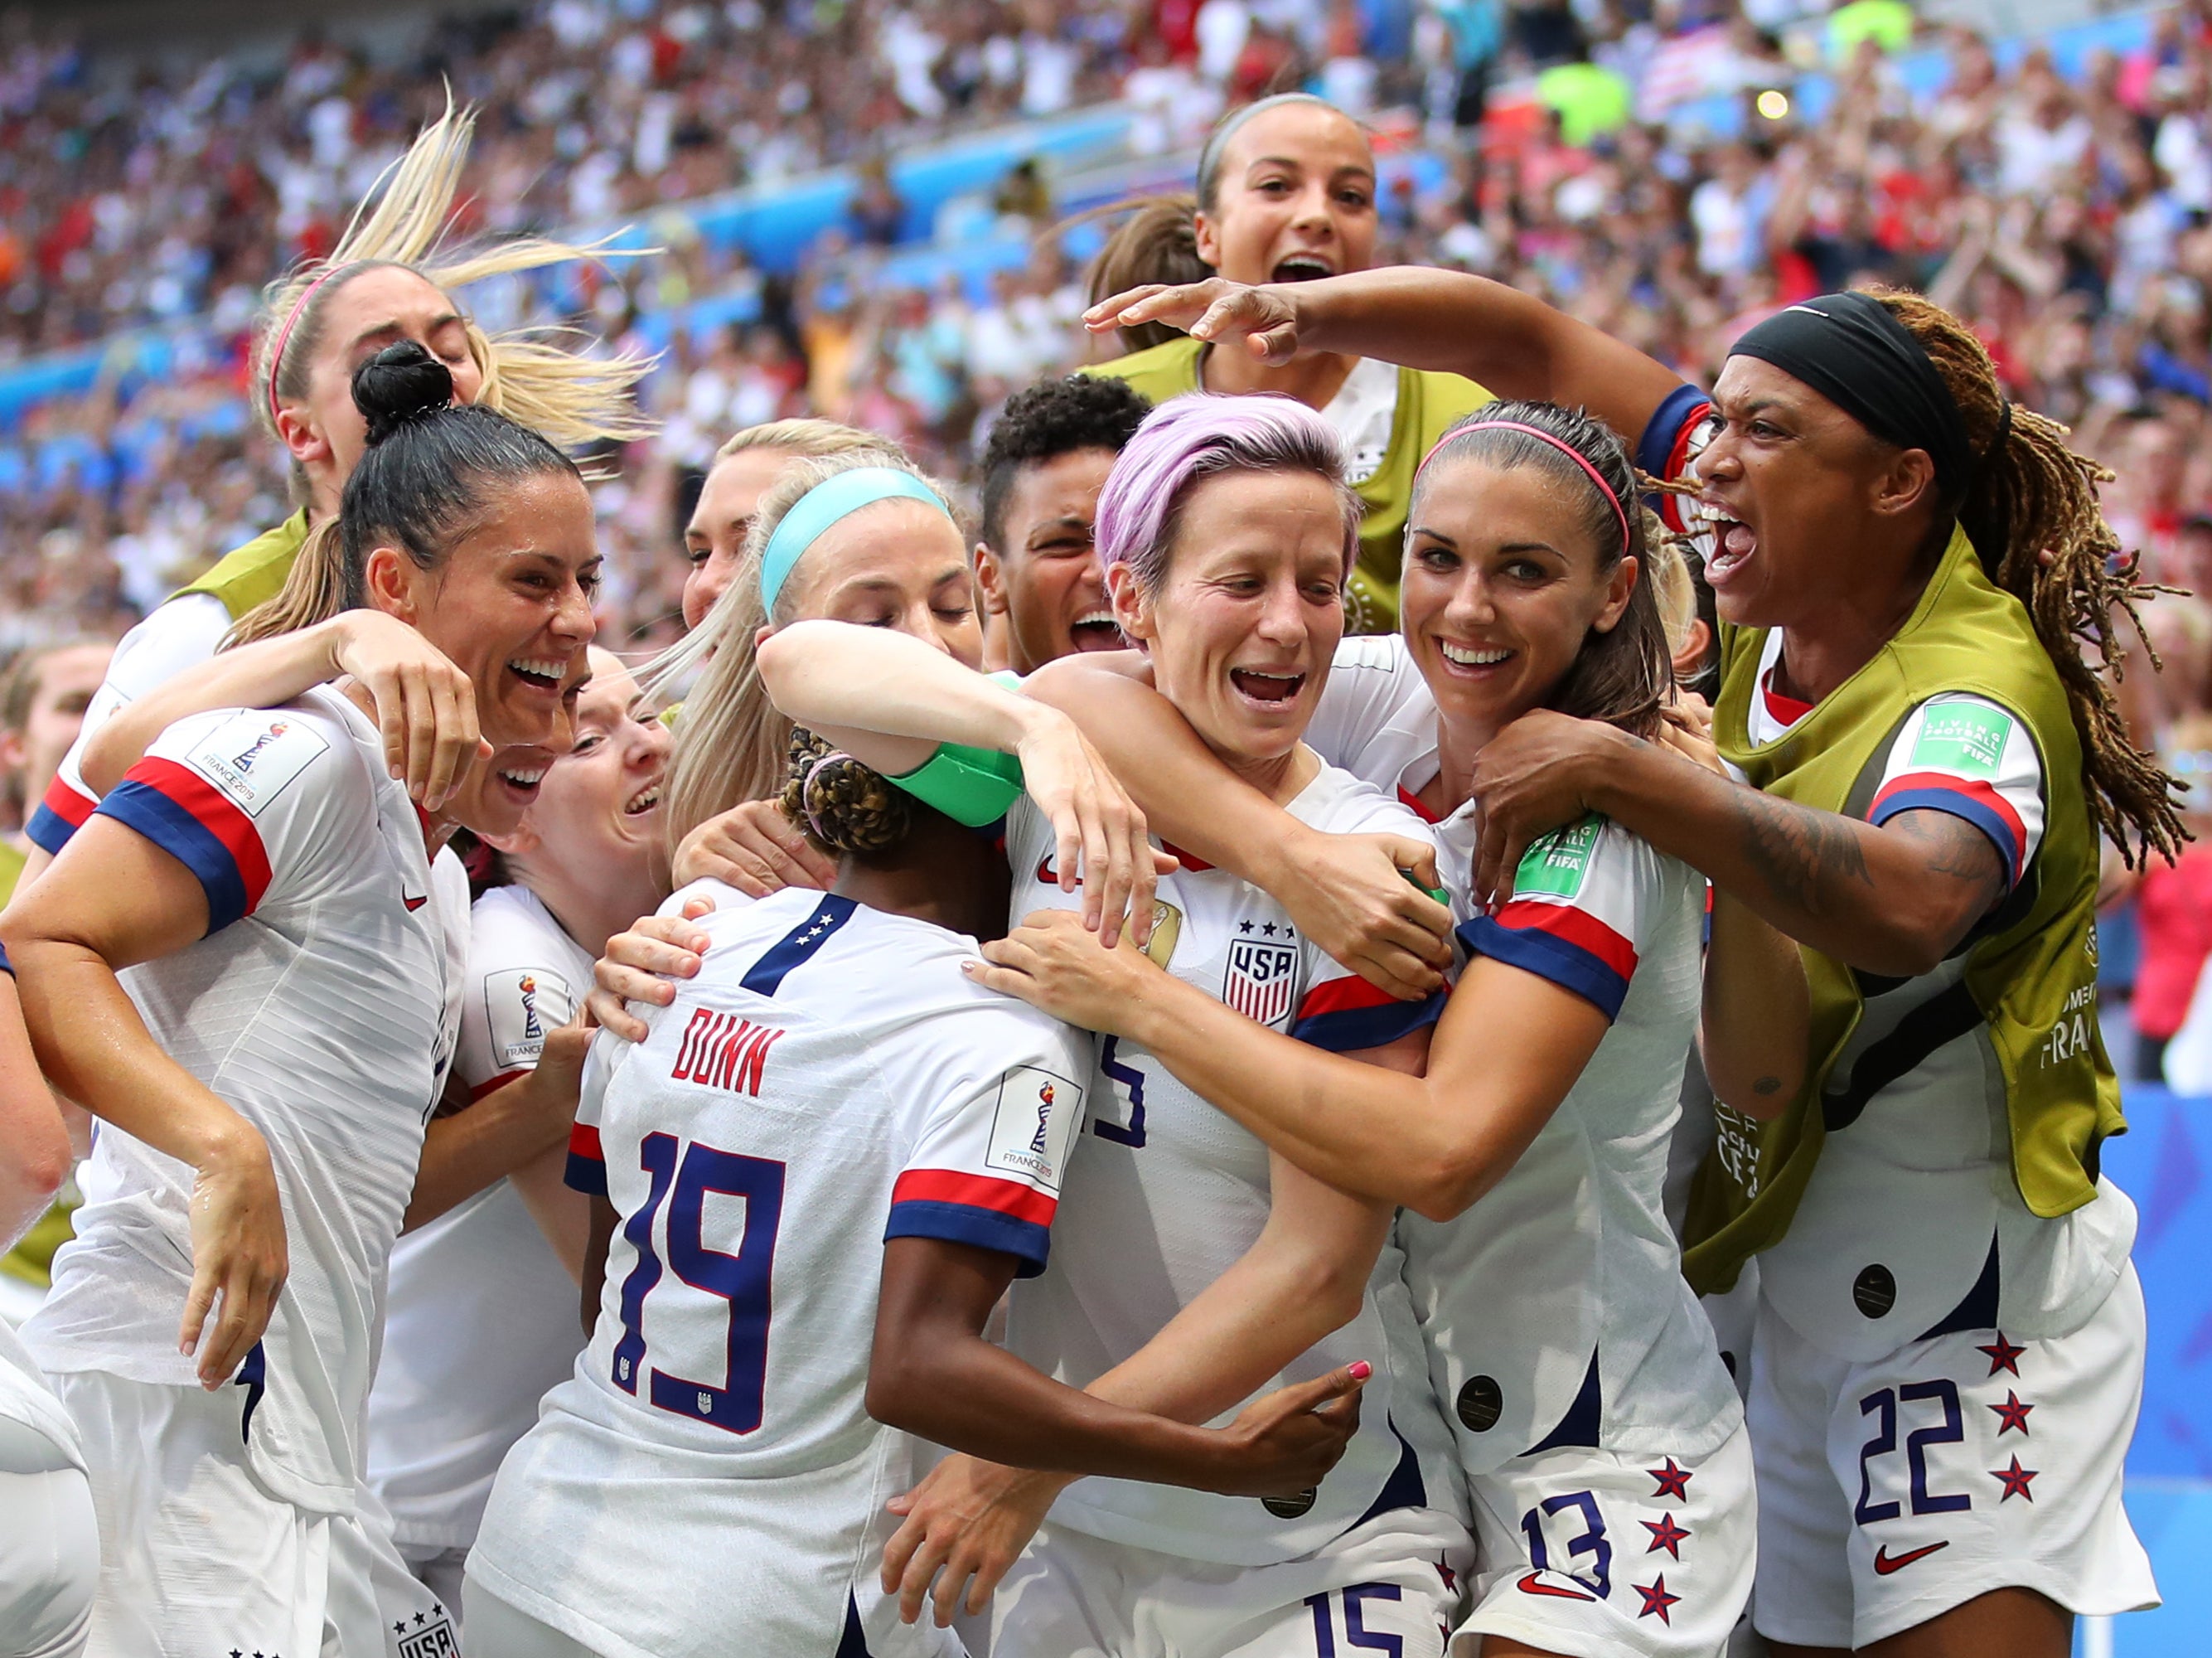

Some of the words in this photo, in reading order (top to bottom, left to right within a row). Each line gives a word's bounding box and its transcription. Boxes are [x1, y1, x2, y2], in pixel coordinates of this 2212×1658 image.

[1924, 727, 1998, 751] FOOTBALL
[1925, 719, 2001, 744] LIVING
[1962, 743, 1995, 768] FIFA
[1546, 853, 1581, 871] FIFA
[1233, 946, 1293, 982] USA
[670, 1006, 787, 1098] DUNN
[611, 1130, 787, 1436] 19
[1854, 1378, 1972, 1526] 22
[1520, 1490, 1613, 1601] 13
[1303, 1581, 1404, 1658] 15
[404, 1626, 452, 1658] USA
